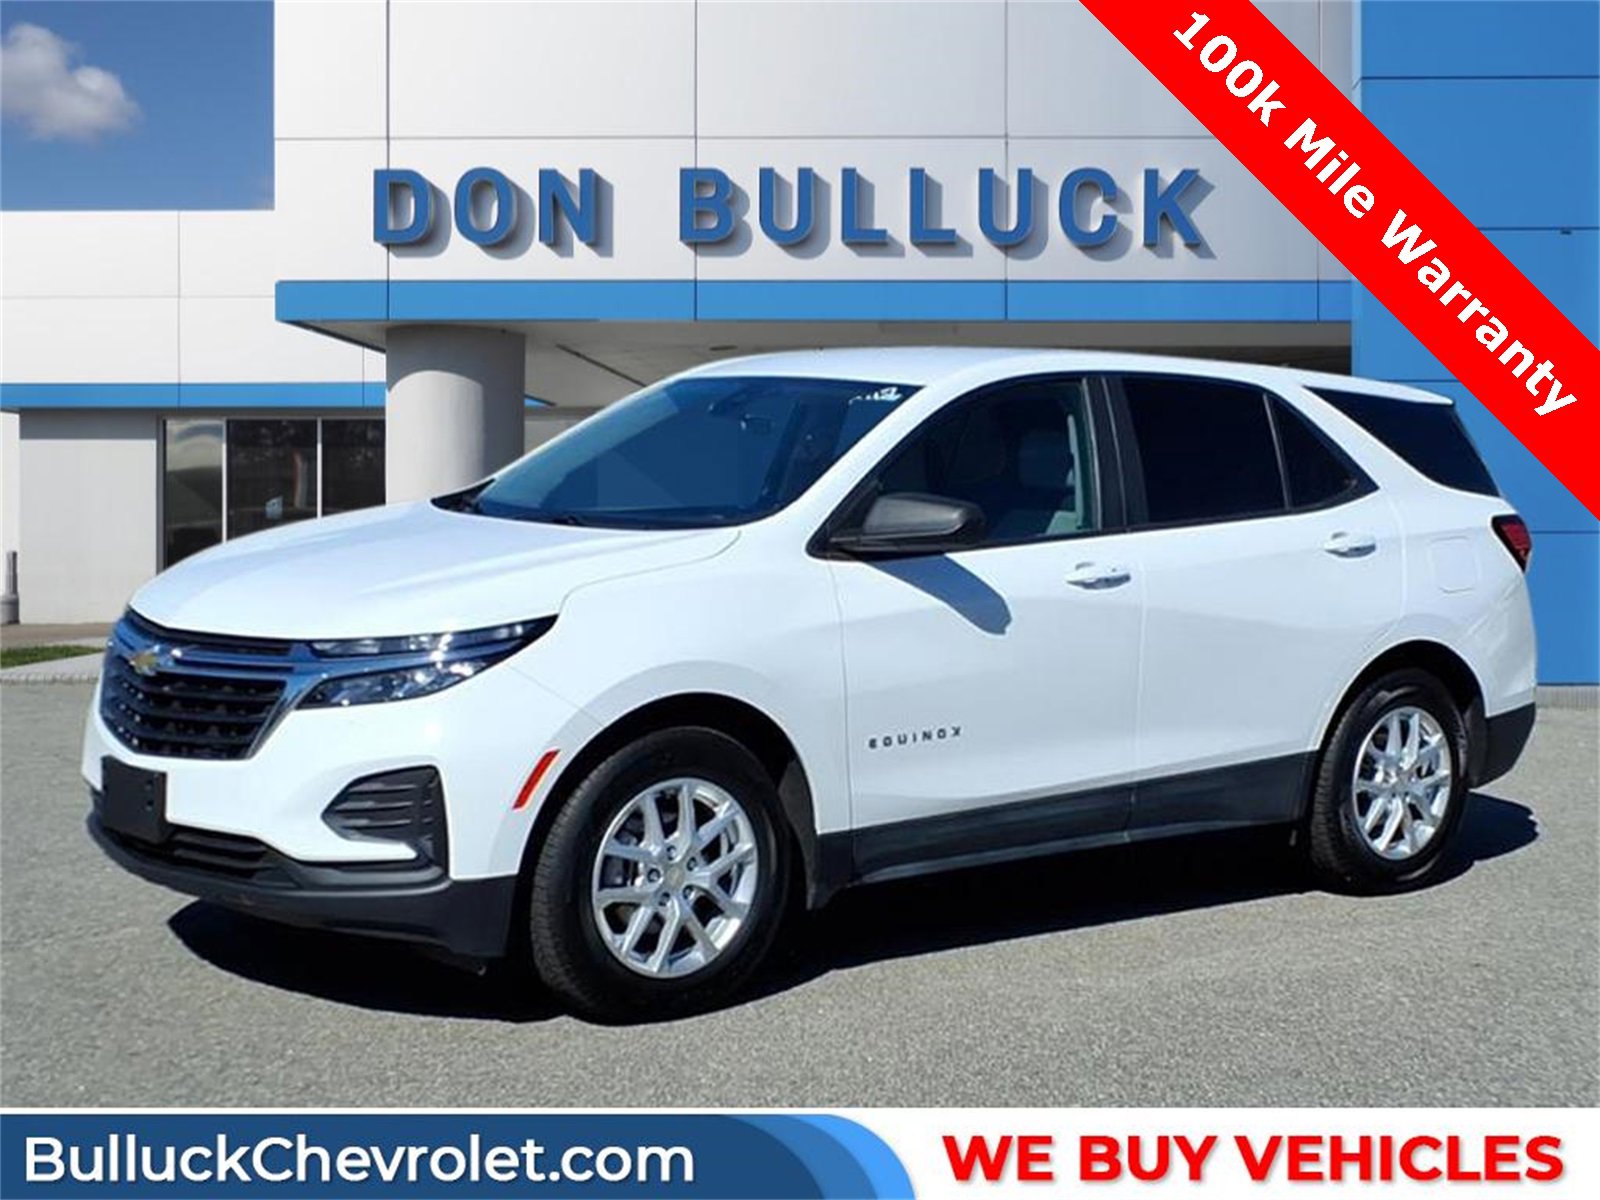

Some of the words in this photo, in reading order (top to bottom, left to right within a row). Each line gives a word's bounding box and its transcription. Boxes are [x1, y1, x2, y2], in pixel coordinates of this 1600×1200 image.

[373, 167, 599, 247] DON
[679, 167, 1204, 248] BULLUCK
[868, 726, 962, 750] EQUINOX
